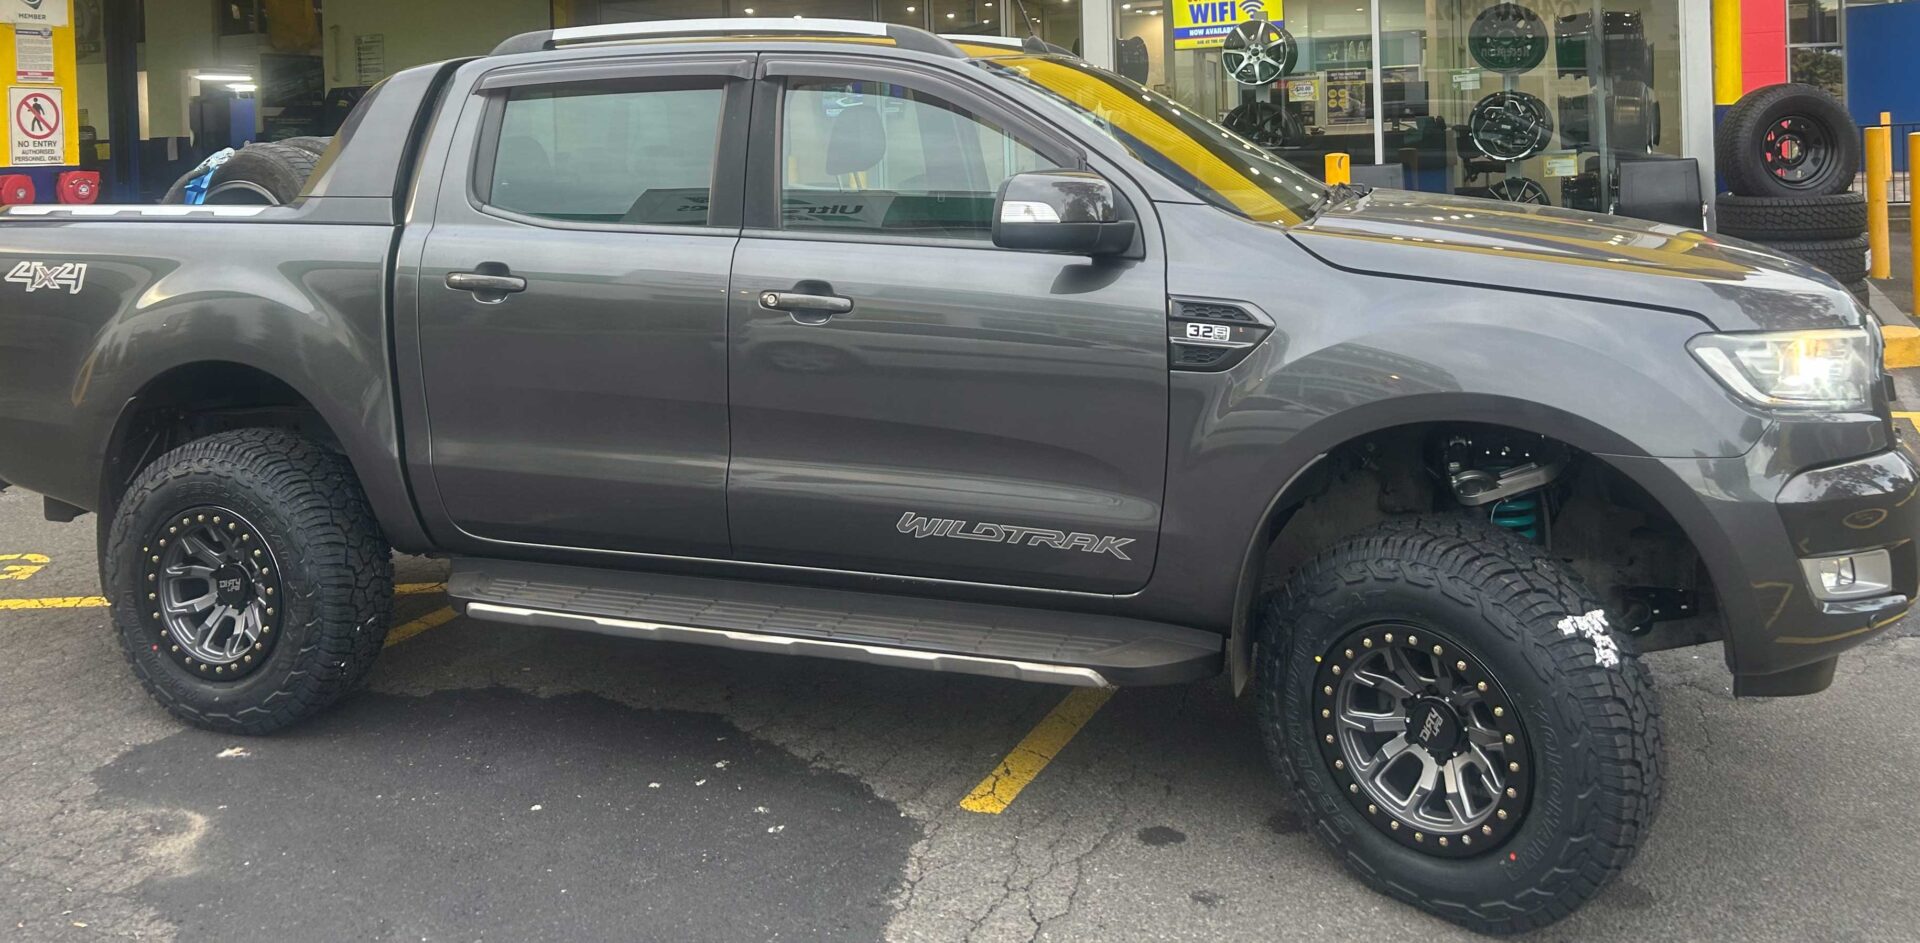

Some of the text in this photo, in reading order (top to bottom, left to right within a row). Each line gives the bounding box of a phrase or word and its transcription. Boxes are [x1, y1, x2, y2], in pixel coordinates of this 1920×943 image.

[18, 12, 47, 20] MEMBER
[1189, 1, 1236, 24] WIFI
[1189, 29, 1204, 37] NOW
[32, 140, 57, 148] ENTRY
[4, 261, 88, 294] 4x4
[896, 511, 1137, 561] WILDTRAK
